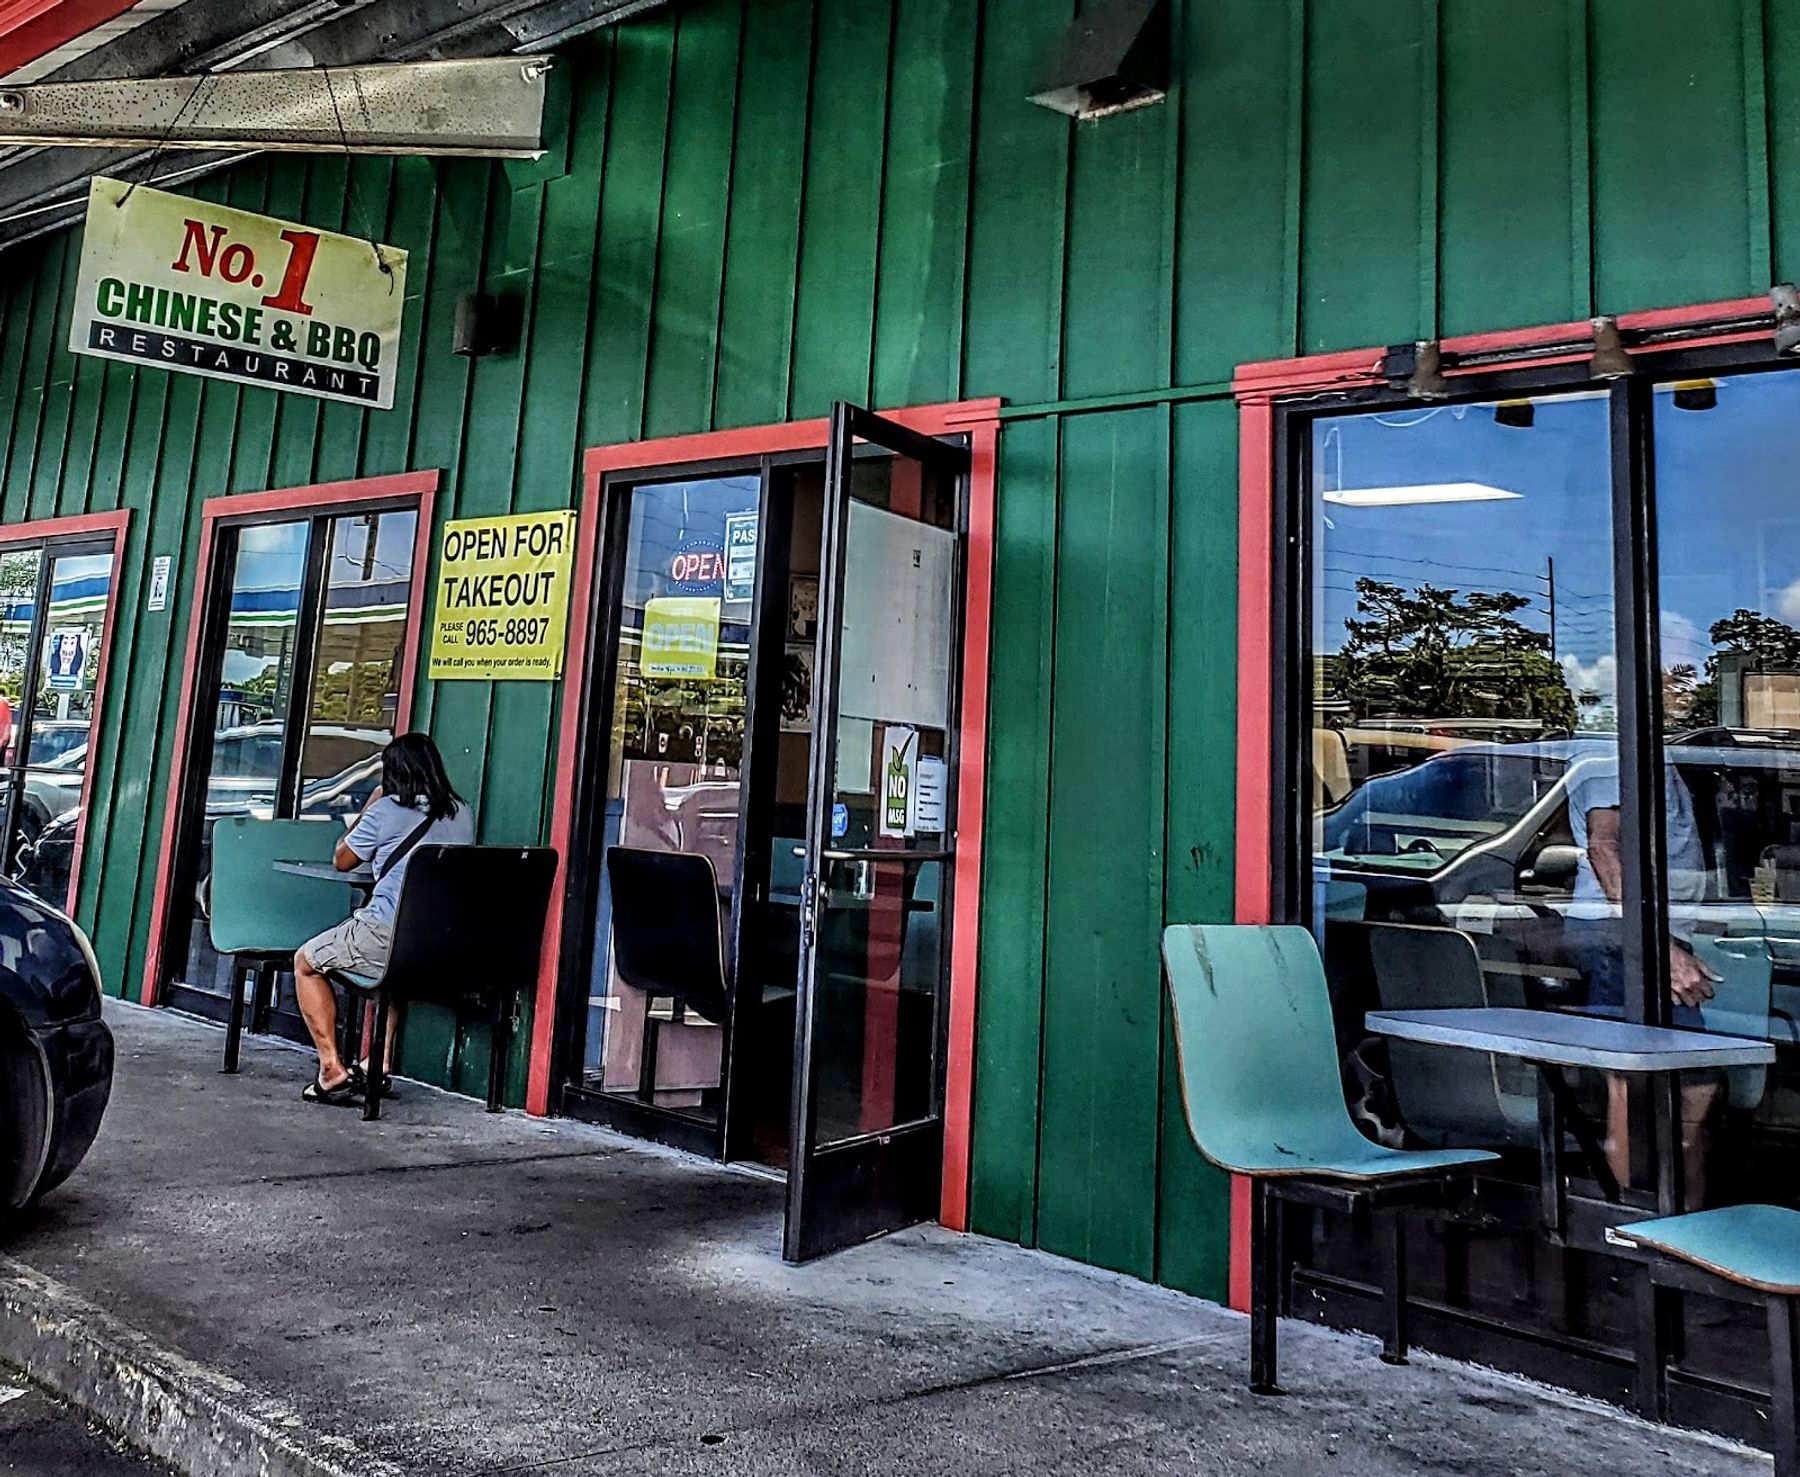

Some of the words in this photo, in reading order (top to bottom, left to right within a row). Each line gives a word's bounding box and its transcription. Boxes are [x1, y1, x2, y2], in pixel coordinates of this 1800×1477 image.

[96, 277, 263, 346] CHINESE
[272, 319, 297, 353] &
[306, 320, 381, 373] BBQ
[100, 327, 372, 394] RESTAURANT
[444, 527, 507, 561] OPEN
[514, 523, 563, 557] FOR
[672, 553, 725, 581] OPEN
[444, 572, 555, 608] TAKEOUT
[440, 622, 464, 632] PLEASE
[465, 617, 549, 646] 965-8897
[443, 635, 459, 644] CALL
[647, 623, 714, 655] OPEN
[432, 658, 441, 666] We
[443, 658, 452, 666] will
[453, 658, 464, 666] call
[464, 659, 475, 668] you
[477, 658, 492, 666] when
[493, 659, 507, 668] your
[508, 657, 524, 666] order
[525, 657, 531, 666] is
[532, 657, 551, 668] ready.
[889, 774, 906, 798] NO
[888, 808, 905, 824] MSG
